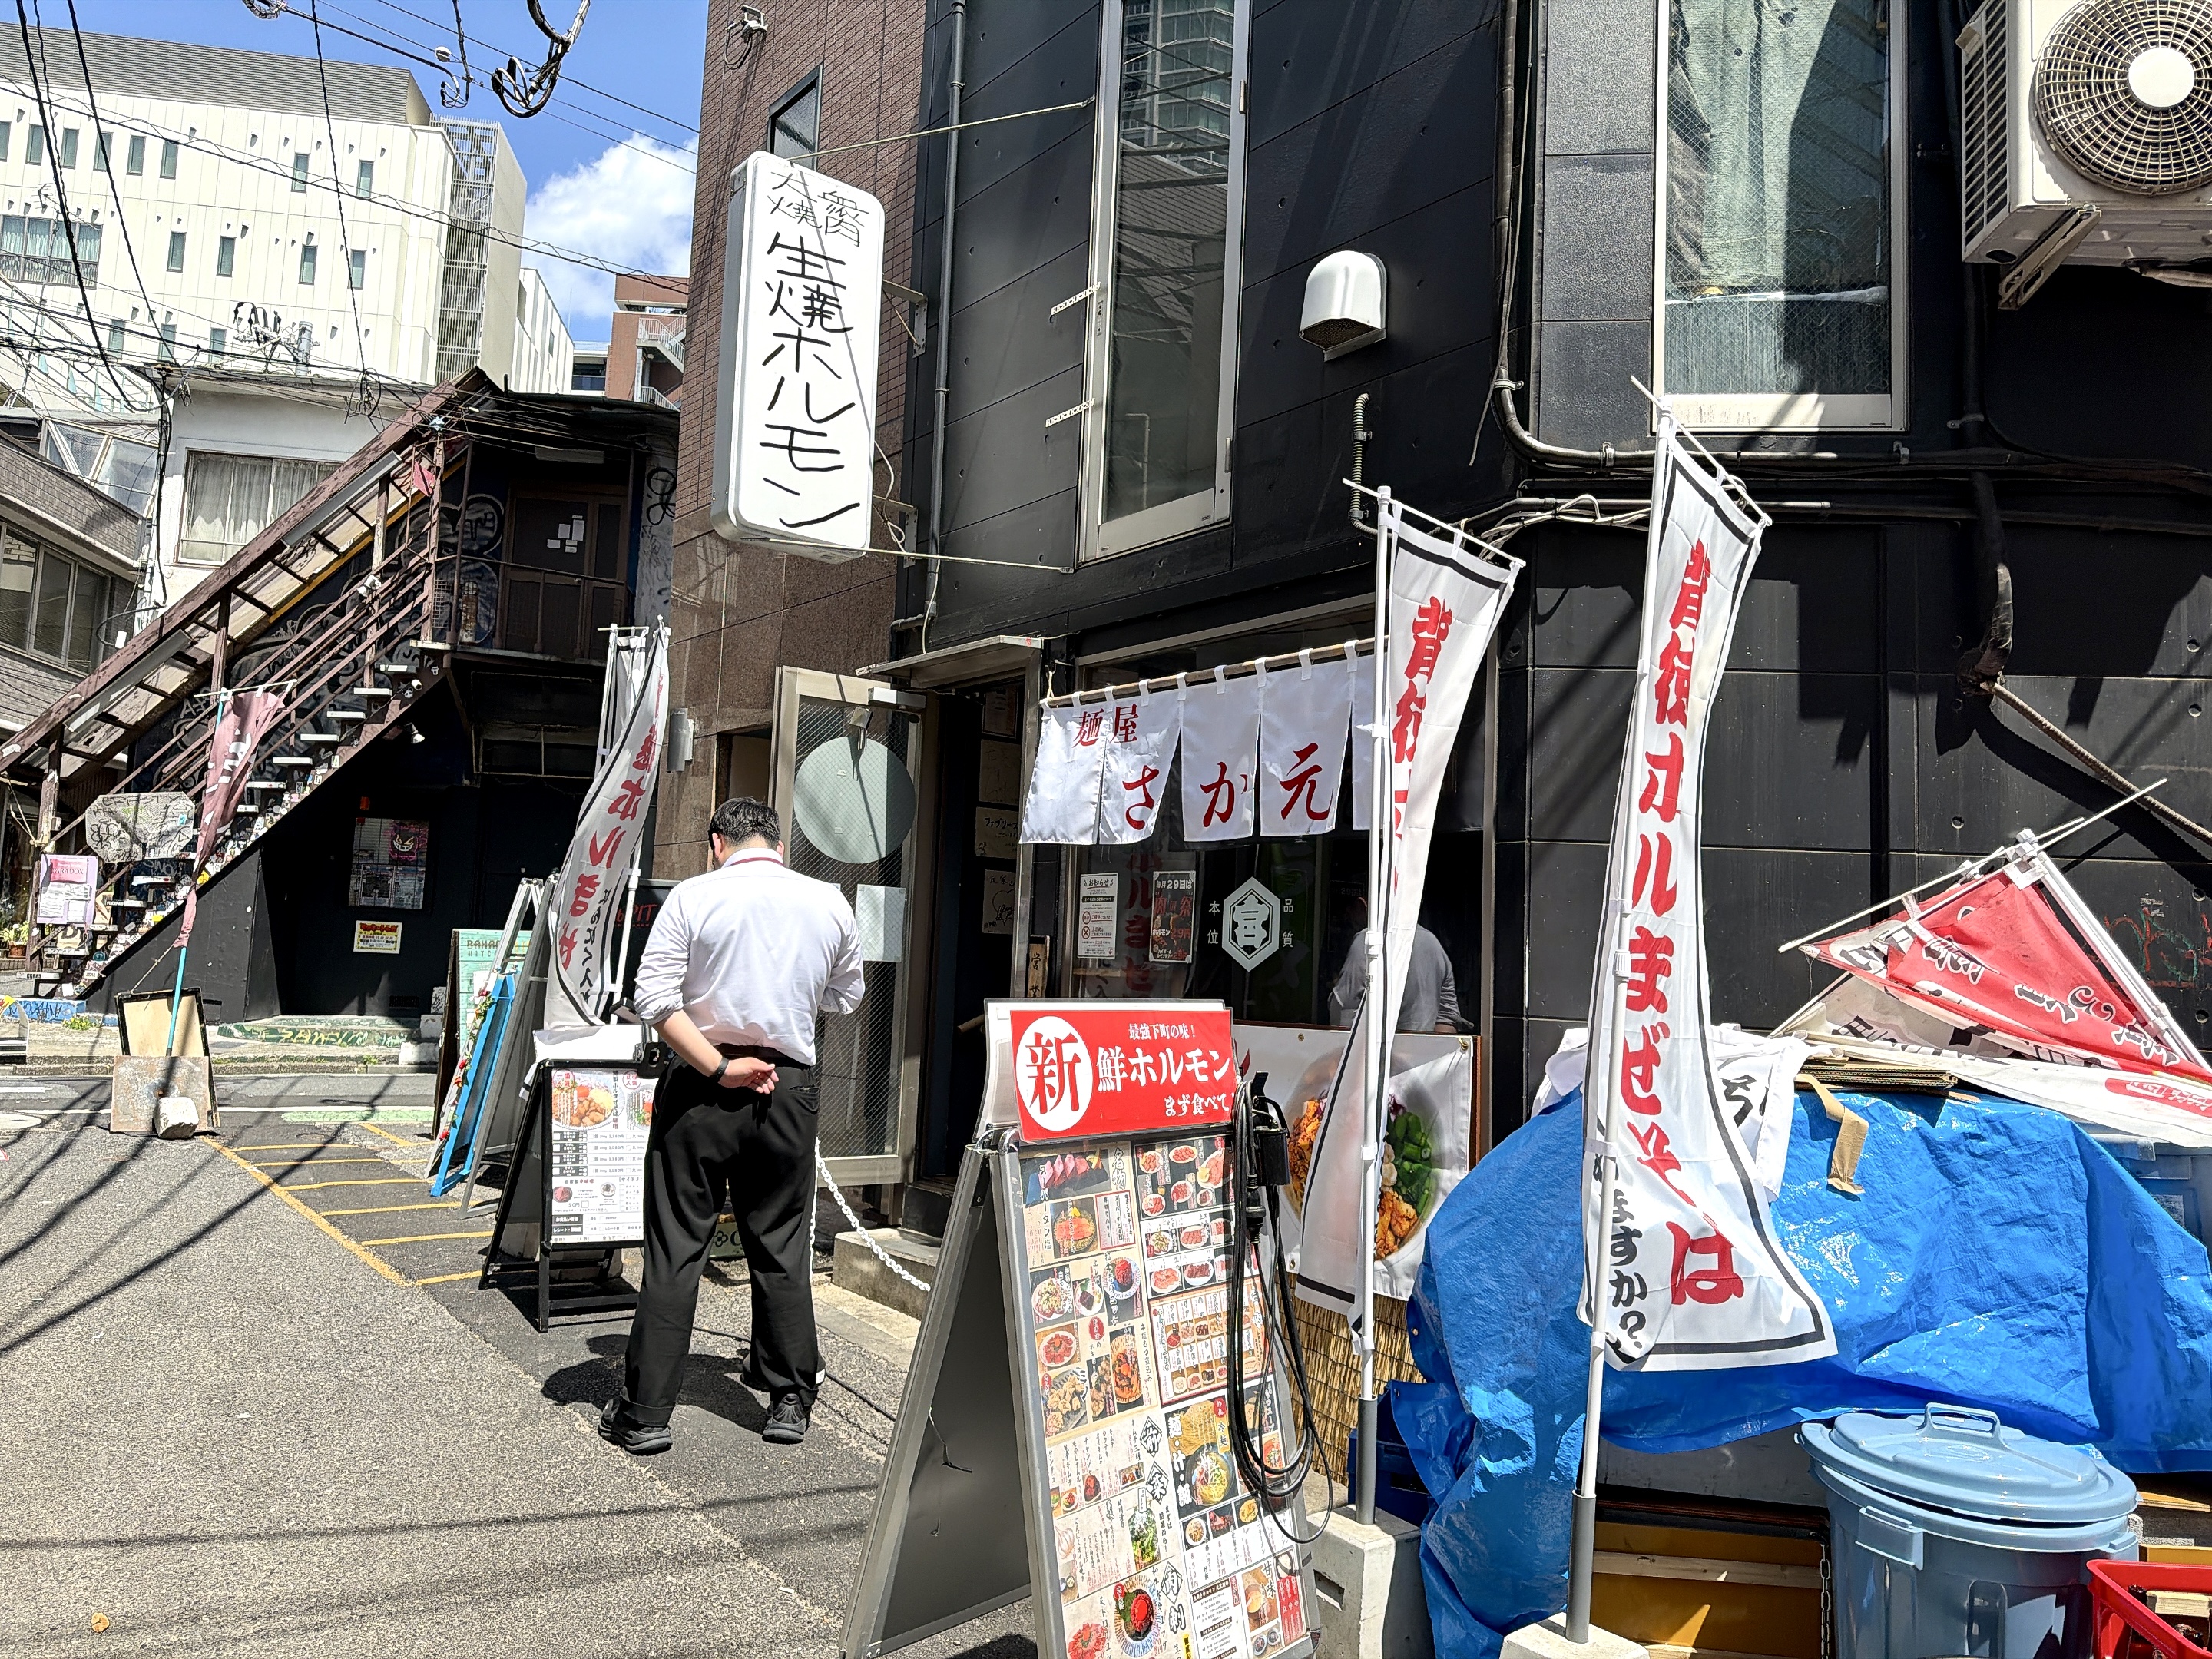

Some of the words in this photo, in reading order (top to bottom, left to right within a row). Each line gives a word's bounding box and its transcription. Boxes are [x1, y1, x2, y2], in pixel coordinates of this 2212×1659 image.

[1073, 704, 1139, 747] 麺屋
[1207, 900, 1220, 945] 本位
[1282, 899, 1294, 948] 品質
[1128, 1023, 1196, 1041] 最強下町の味!
[1025, 1031, 1081, 1115] 新
[1096, 1045, 1230, 1093] 鮮ホルモン
[1164, 1092, 1234, 1118] まず食べて
[1108, 1147, 1128, 1191] 名物
[1141, 1423, 1167, 1505] 前菜
[1262, 1559, 1277, 1601] 甘味
